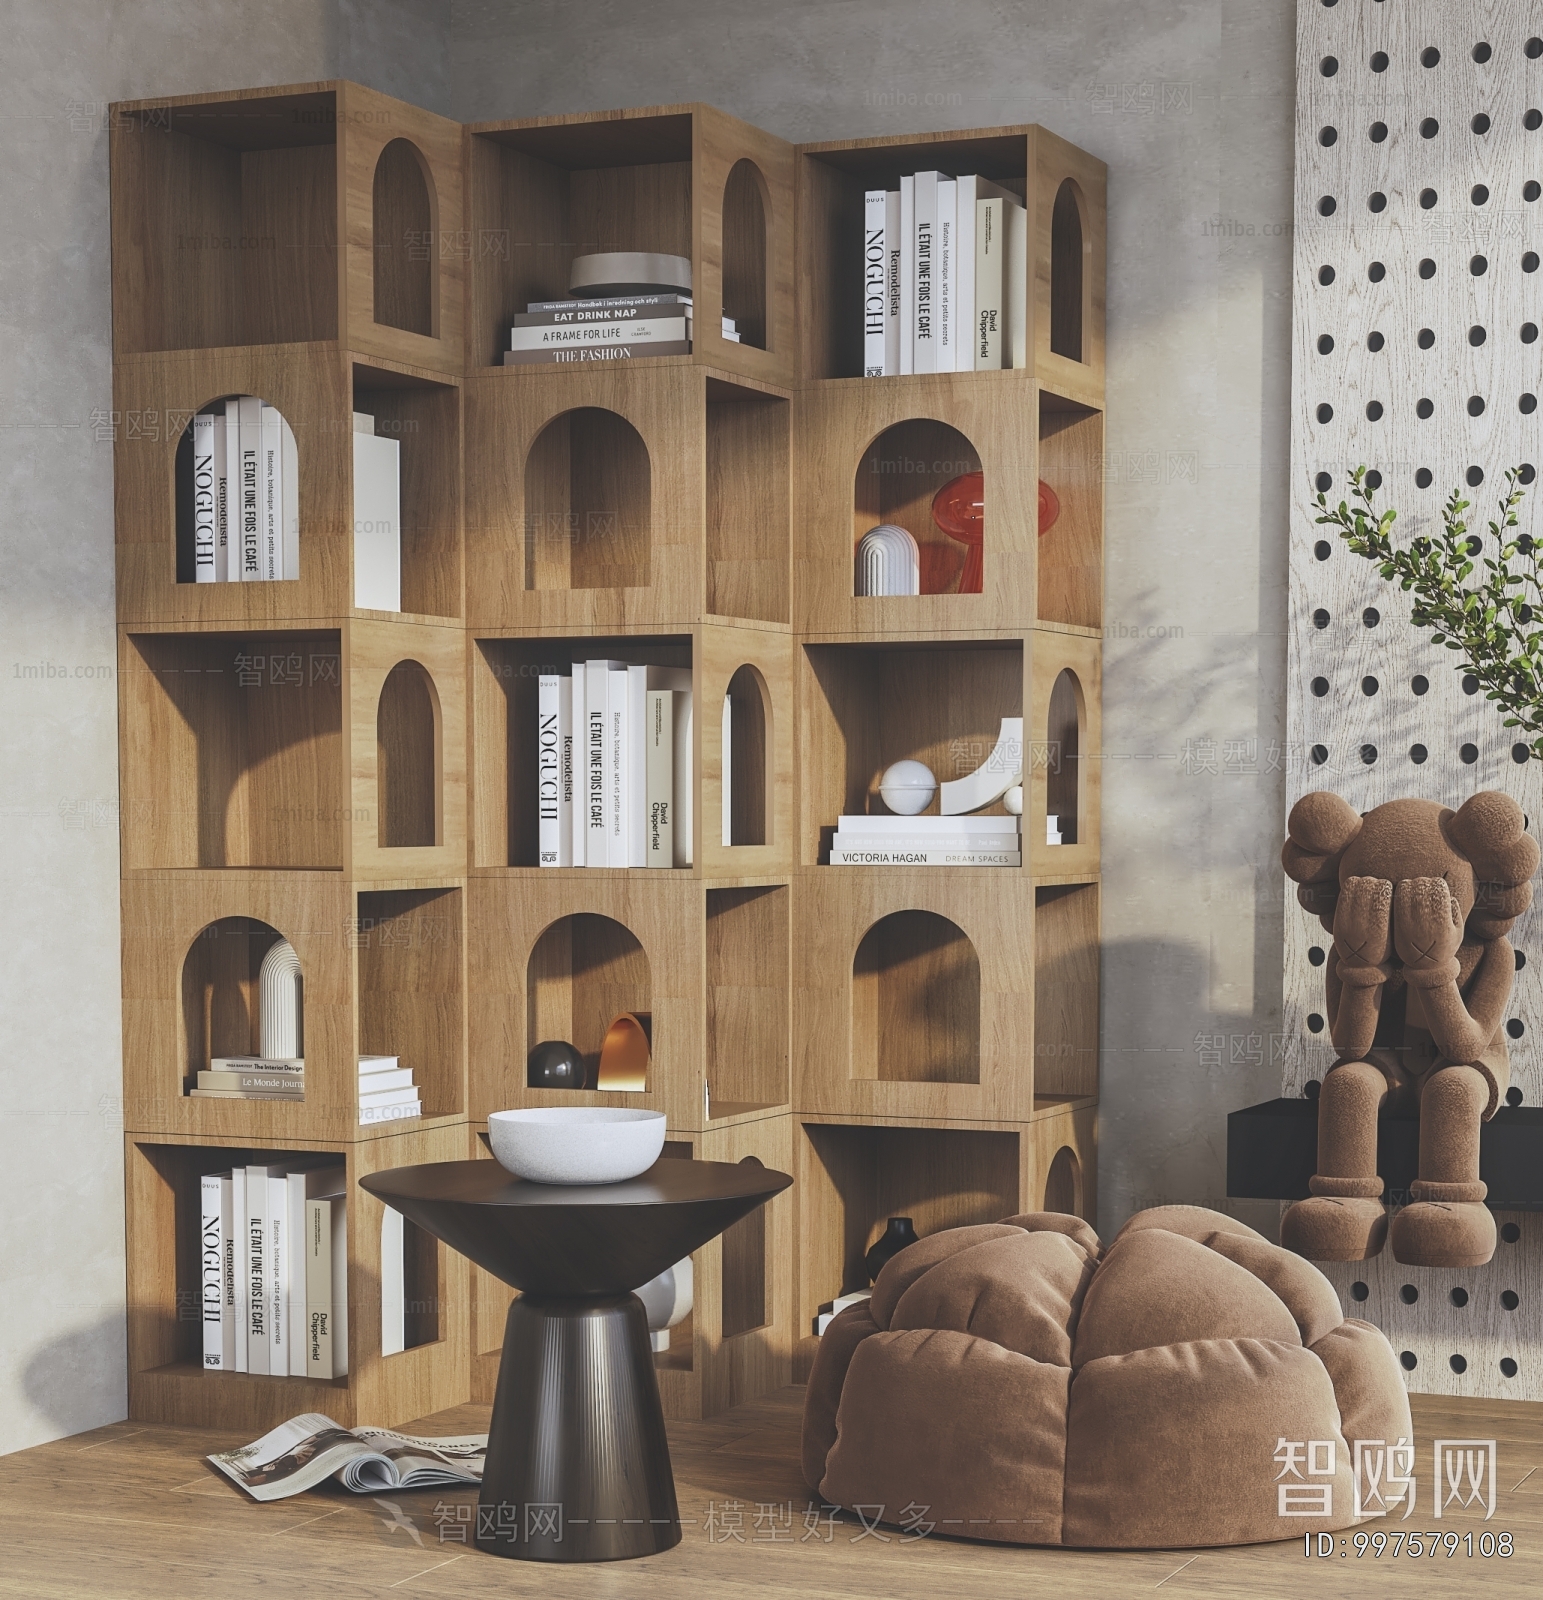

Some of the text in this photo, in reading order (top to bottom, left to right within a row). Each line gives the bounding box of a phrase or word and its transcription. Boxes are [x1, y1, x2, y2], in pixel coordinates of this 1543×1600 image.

[577, 300, 602, 308] Handbok
[866, 229, 884, 336] NOGUCHI
[890, 249, 900, 317] Remodelista
[918, 223, 932, 339] IL ÉTAIT UNE FOIS LE CAFÉ
[543, 328, 621, 341] A FRAME FOR LIFE
[554, 309, 637, 322] EAT DRINK NAP
[980, 310, 989, 358] Chipperfield
[989, 310, 997, 332] David
[553, 346, 631, 363] THE FASHION
[195, 454, 214, 566] NOGUCHI
[244, 450, 259, 572] IL ÉTAIT UNE FOIS LE CAFÉ
[540, 713, 558, 820] NOGUCHI
[564, 735, 573, 802] Remodelista
[590, 712, 604, 828] IL ÉTAIT UNE FOIS LE CAFÉ
[651, 802, 660, 850] Chipperfield
[660, 802, 668, 824] David
[842, 853, 927, 863] VICTORIA HAGAN
[946, 855, 1009, 863] DREAM SPACES
[243, 1077, 252, 1086] Le
[254, 1078, 280, 1087] Monde
[254, 1063, 264, 1071] The
[284, 1064, 303, 1072] Design
[203, 1214, 221, 1323] NOGUCHI
[226, 1238, 235, 1306] Remodelista
[251, 1218, 265, 1336] IL ÉTAIT UNE FOIS LE CAFÉ
[311, 1312, 320, 1361] Chipperfield
[320, 1313, 328, 1335] David
